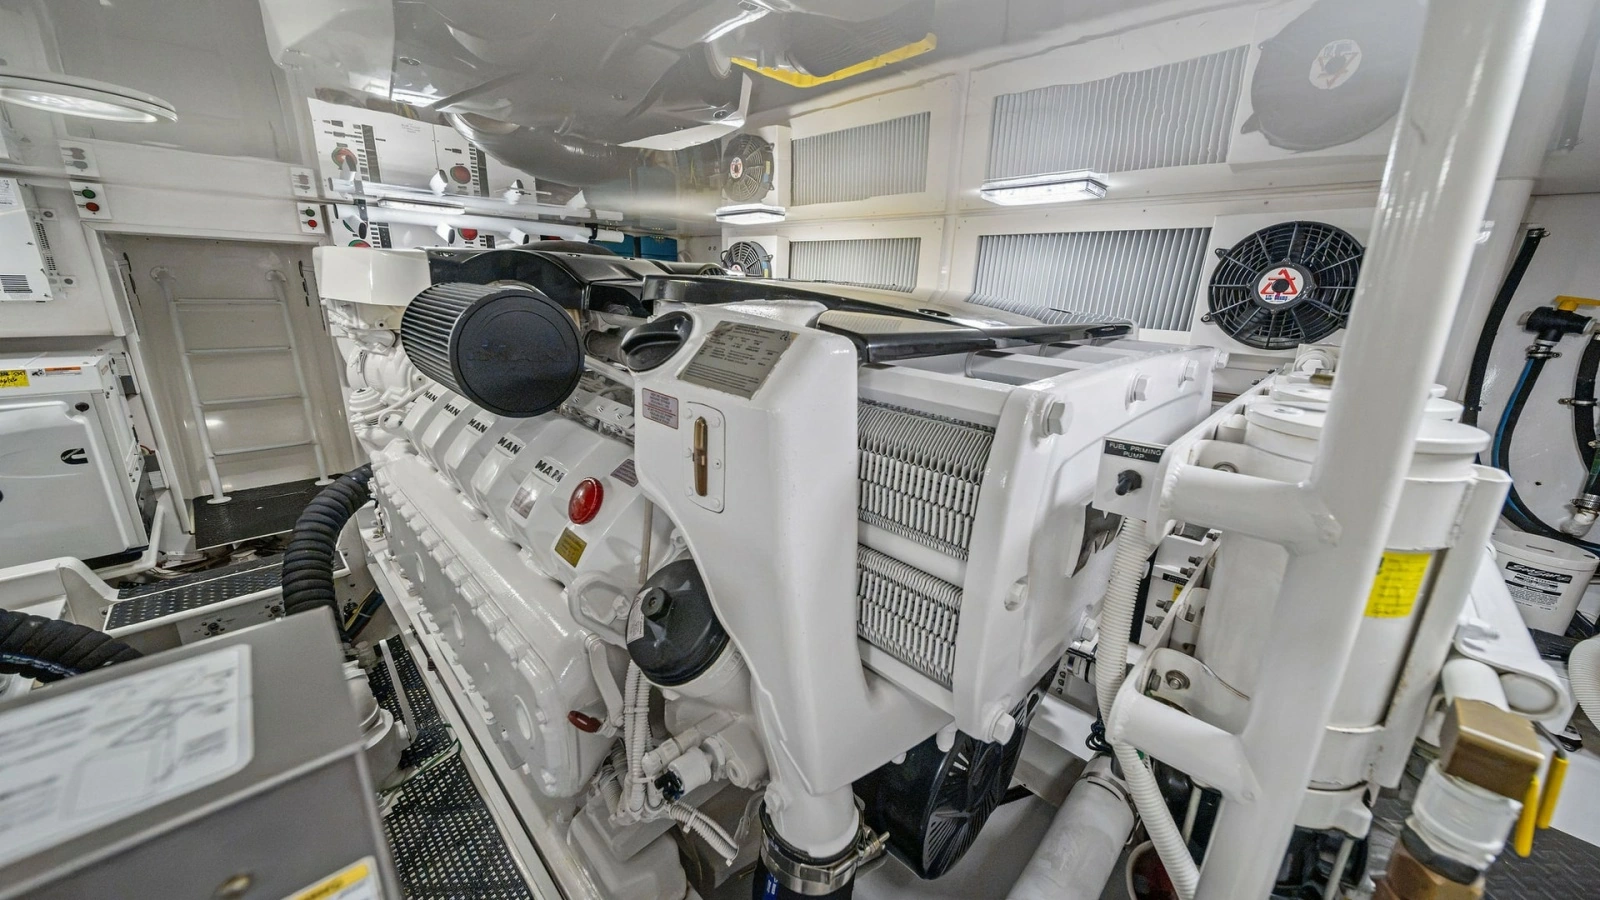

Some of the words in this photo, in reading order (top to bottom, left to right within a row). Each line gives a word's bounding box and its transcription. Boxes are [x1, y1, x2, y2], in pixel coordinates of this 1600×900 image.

[423, 390, 438, 402] MAN
[444, 403, 460, 416] MAN
[468, 418, 487, 433] MAN
[497, 436, 521, 454] MAN
[1109, 442, 1126, 450] FUEL
[1130, 445, 1161, 456] PRIMING
[535, 459, 565, 482] MAN
